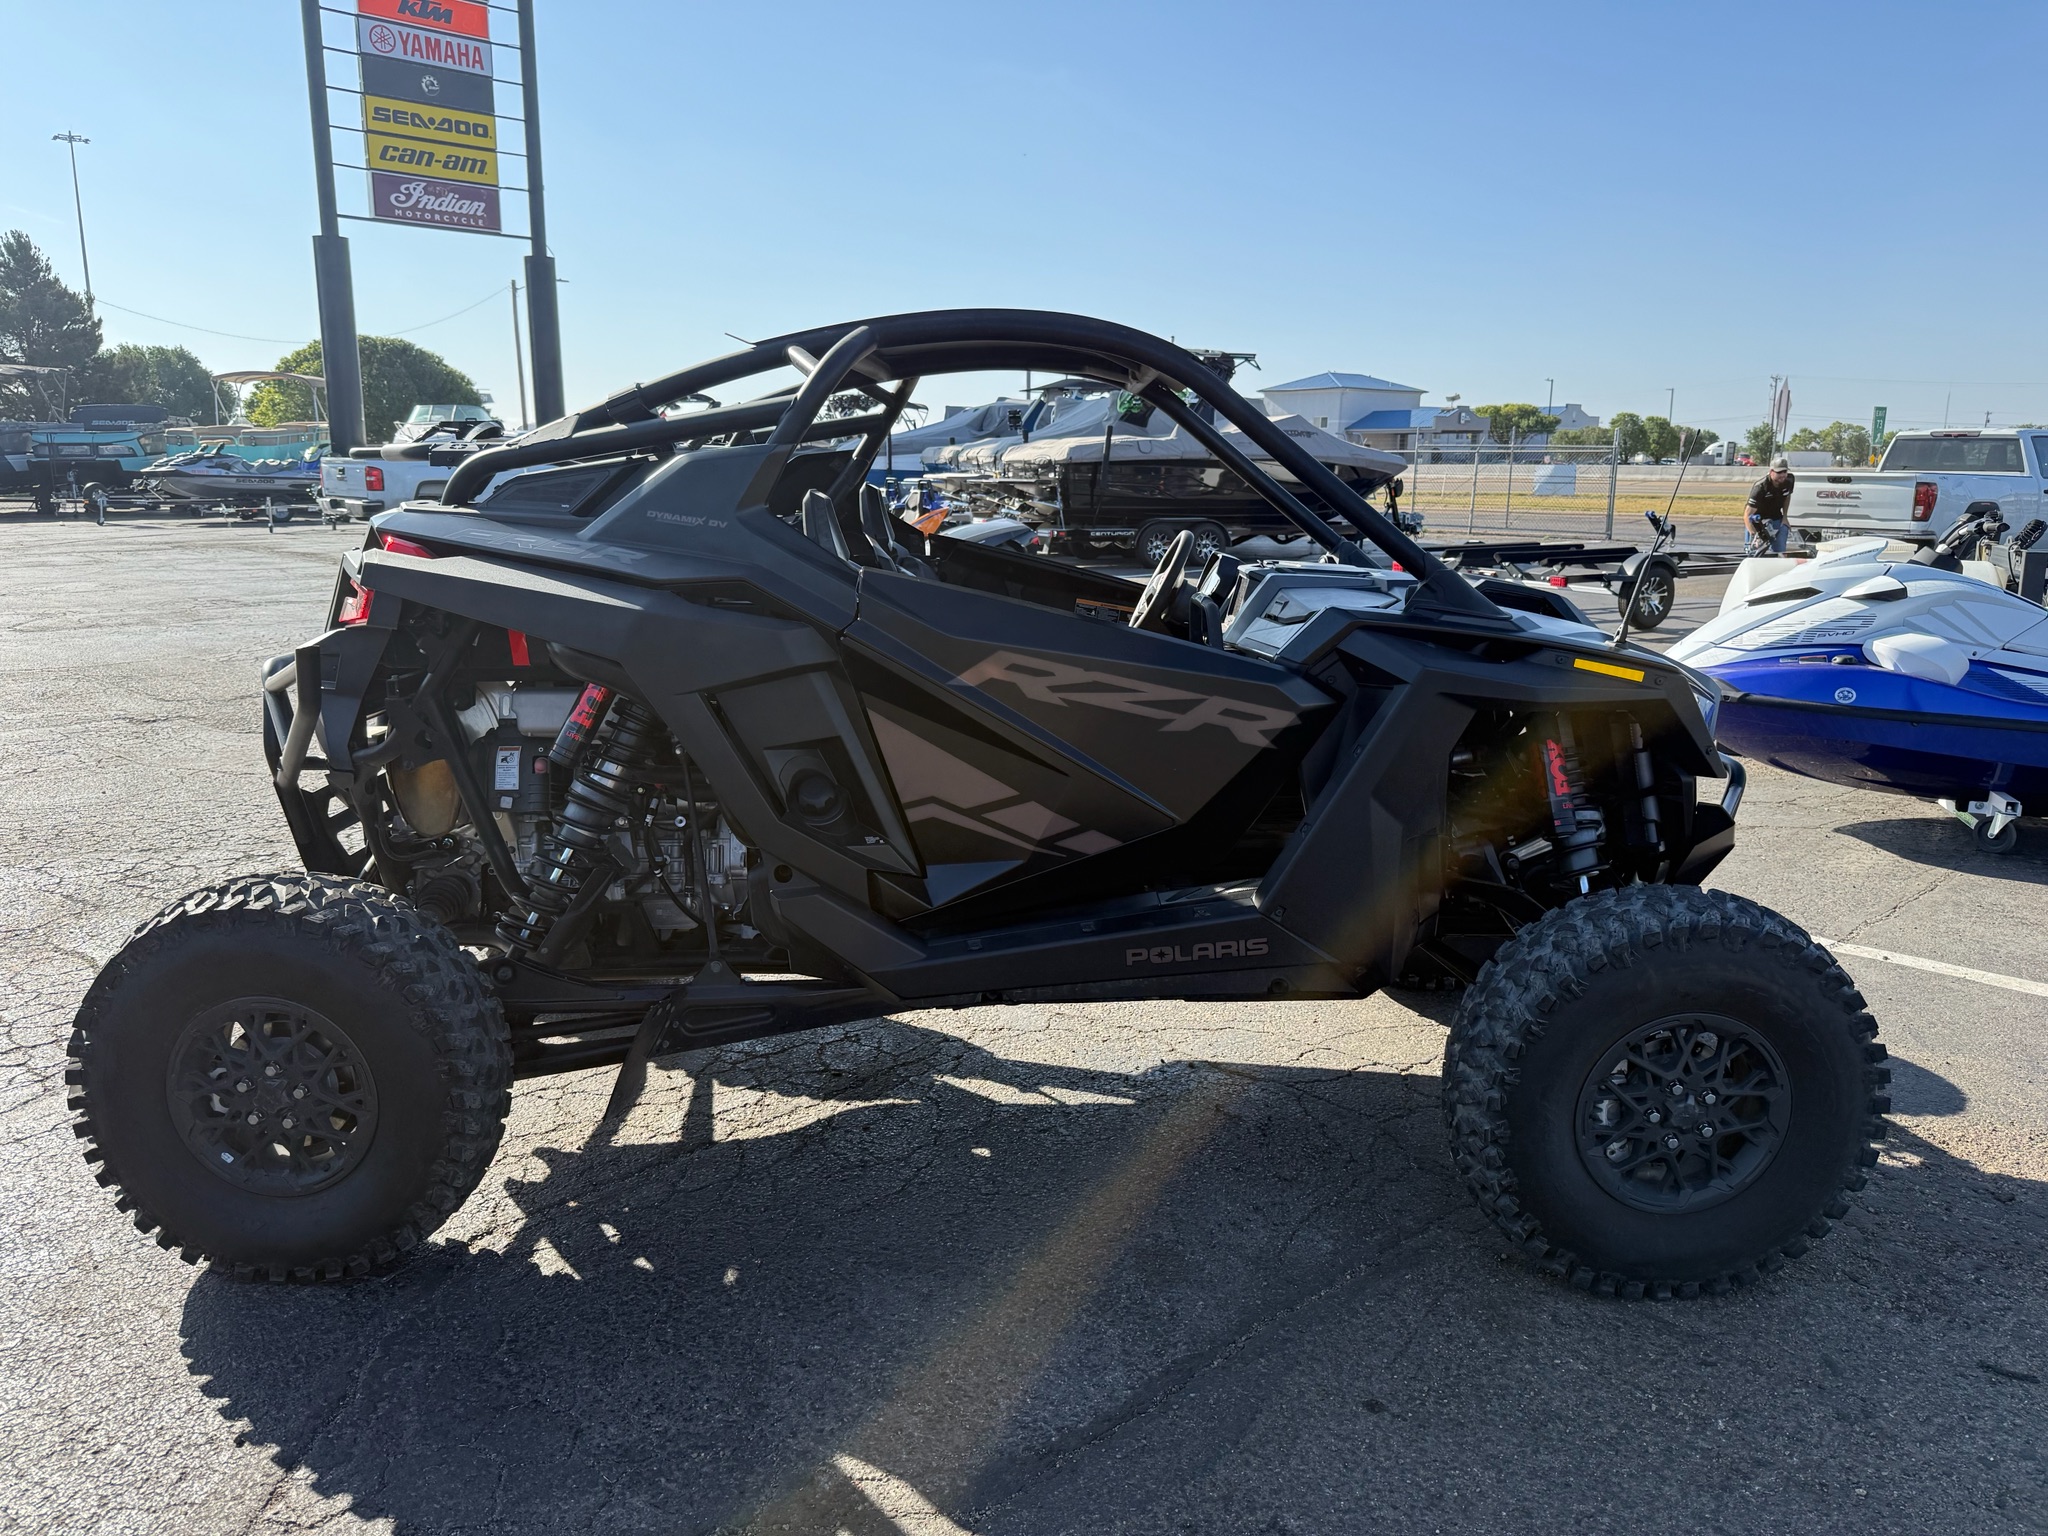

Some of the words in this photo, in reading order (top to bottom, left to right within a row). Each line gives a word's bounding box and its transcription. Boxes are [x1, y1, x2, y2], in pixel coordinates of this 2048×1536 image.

[398, 30, 485, 70] YAMAHA
[390, 182, 486, 216] Indian
[395, 209, 484, 226] MOTORCYCLE
[1816, 490, 1862, 500] GMC
[646, 510, 707, 526] DYNAMIX
[708, 519, 728, 528] DV
[945, 650, 1301, 749] RZR
[1126, 937, 1270, 966] POLARIS
